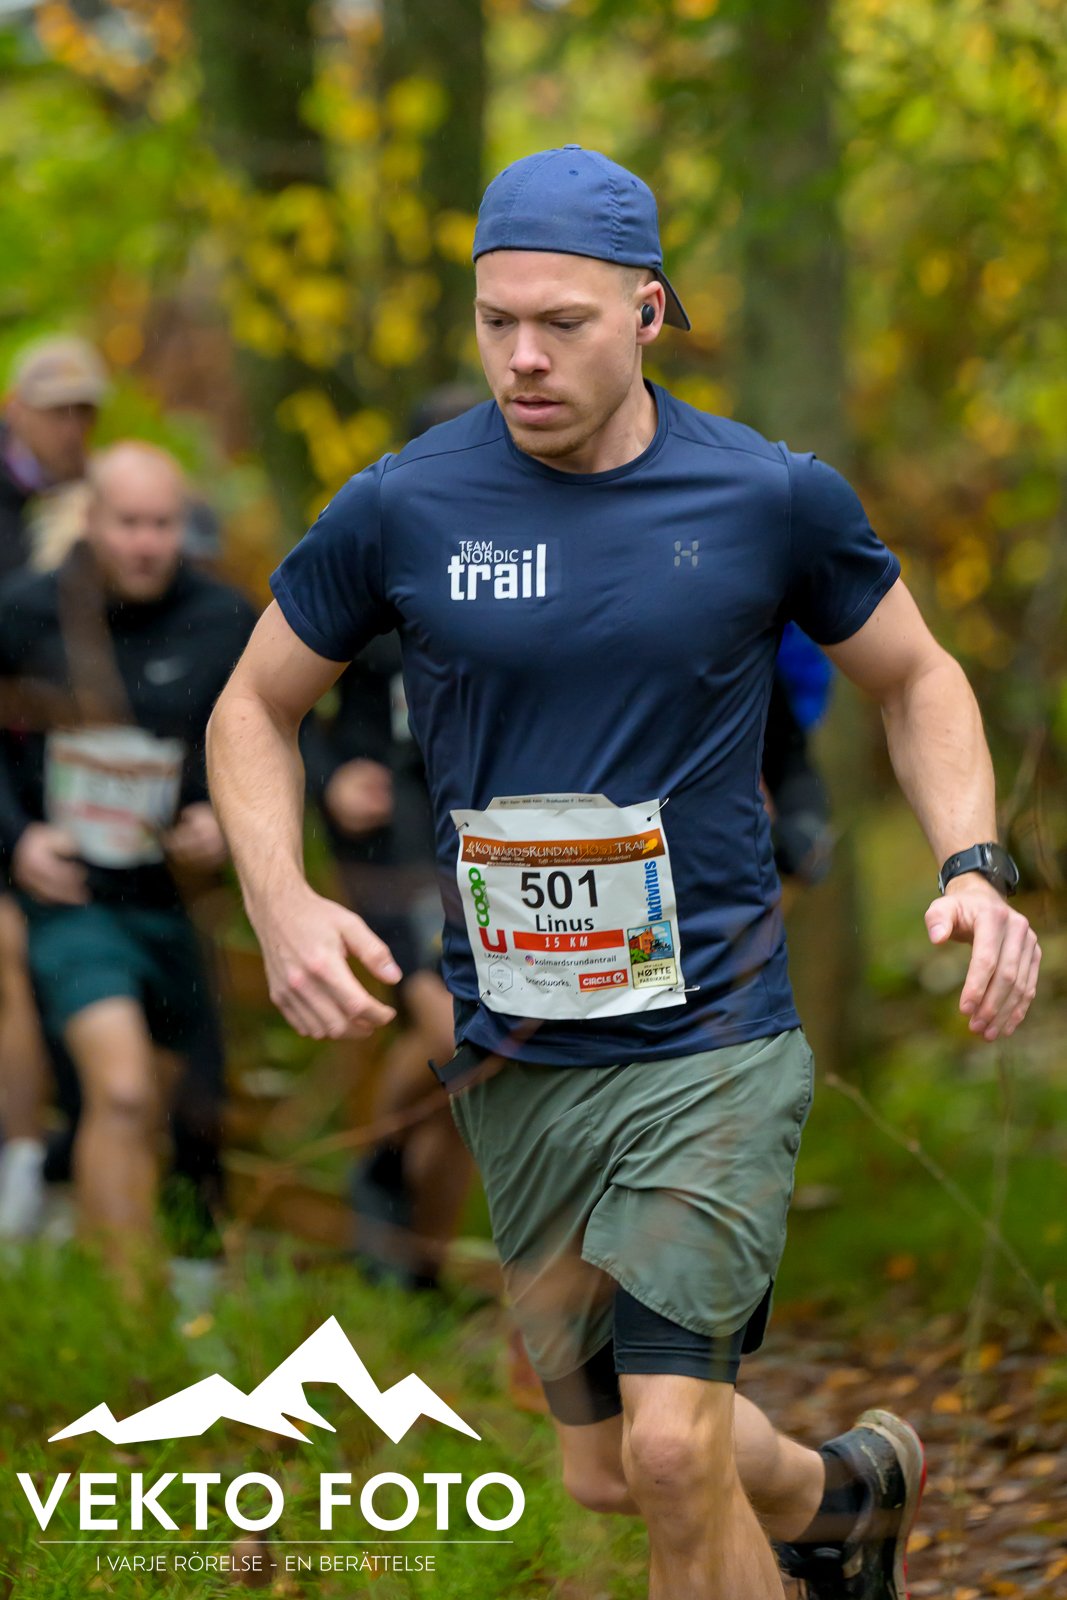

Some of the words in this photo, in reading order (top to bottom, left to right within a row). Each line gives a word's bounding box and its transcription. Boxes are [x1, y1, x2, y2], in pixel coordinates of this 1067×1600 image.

[458, 541, 493, 551] TEAM
[460, 549, 519, 564] NORDIC
[447, 543, 547, 600] trail
[520, 869, 599, 909] 501
[644, 860, 662, 922] Aktivitus
[535, 914, 595, 932] Linus
[545, 936, 560, 948] 15
[569, 936, 588, 948] KM
[534, 955, 617, 969] kolmardsrundantrail
[637, 966, 671, 978] NØTTE
[582, 975, 612, 986] CIRCLE
